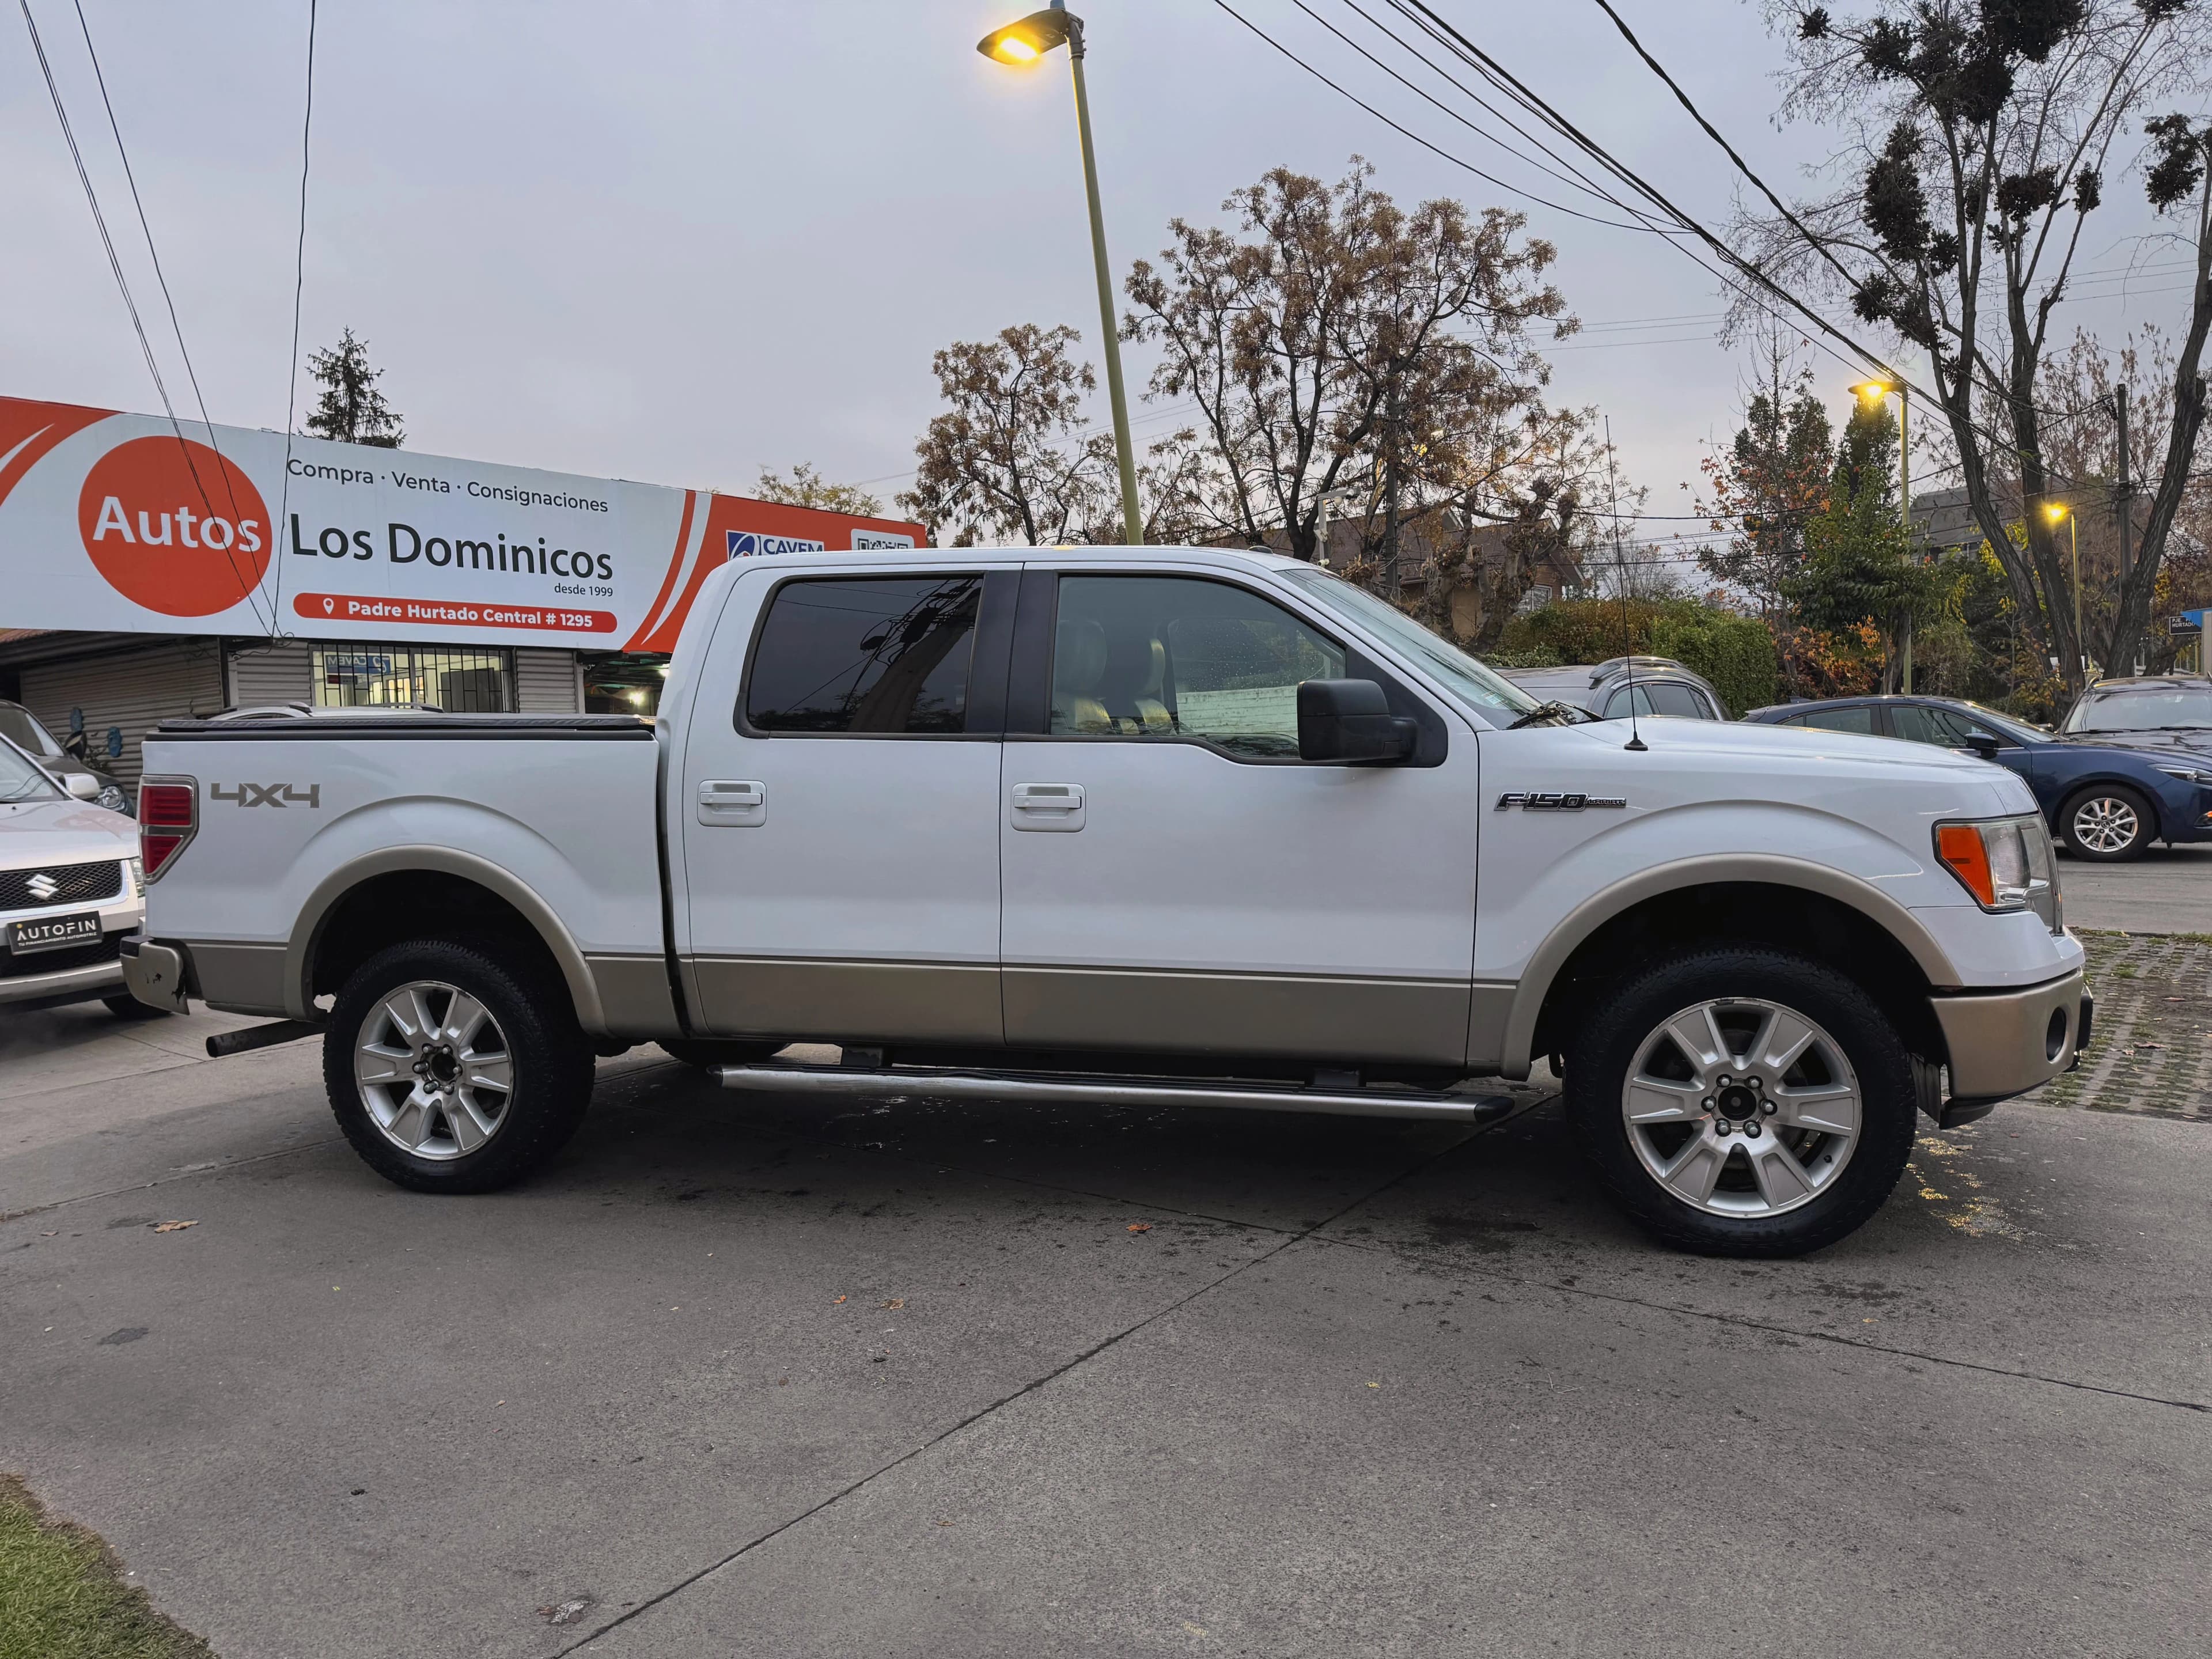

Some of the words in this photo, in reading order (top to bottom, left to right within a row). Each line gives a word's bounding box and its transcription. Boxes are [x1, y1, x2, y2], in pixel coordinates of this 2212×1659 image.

[287, 459, 374, 484] Compra
[392, 471, 450, 493] Venta
[467, 482, 608, 512] Consignaciones
[92, 495, 261, 552] Autos
[290, 513, 373, 560] Los
[388, 523, 613, 580] Dominicos
[554, 583, 586, 596] desde
[589, 586, 613, 597] 1999
[348, 601, 402, 617] Padre
[407, 604, 479, 622] Hurtado
[483, 609, 541, 625] Central
[546, 613, 556, 625] #
[560, 614, 593, 628] 1295
[17, 919, 96, 941] AUTOFIN
[67, 931, 97, 940] AUTOMOTRIZ
